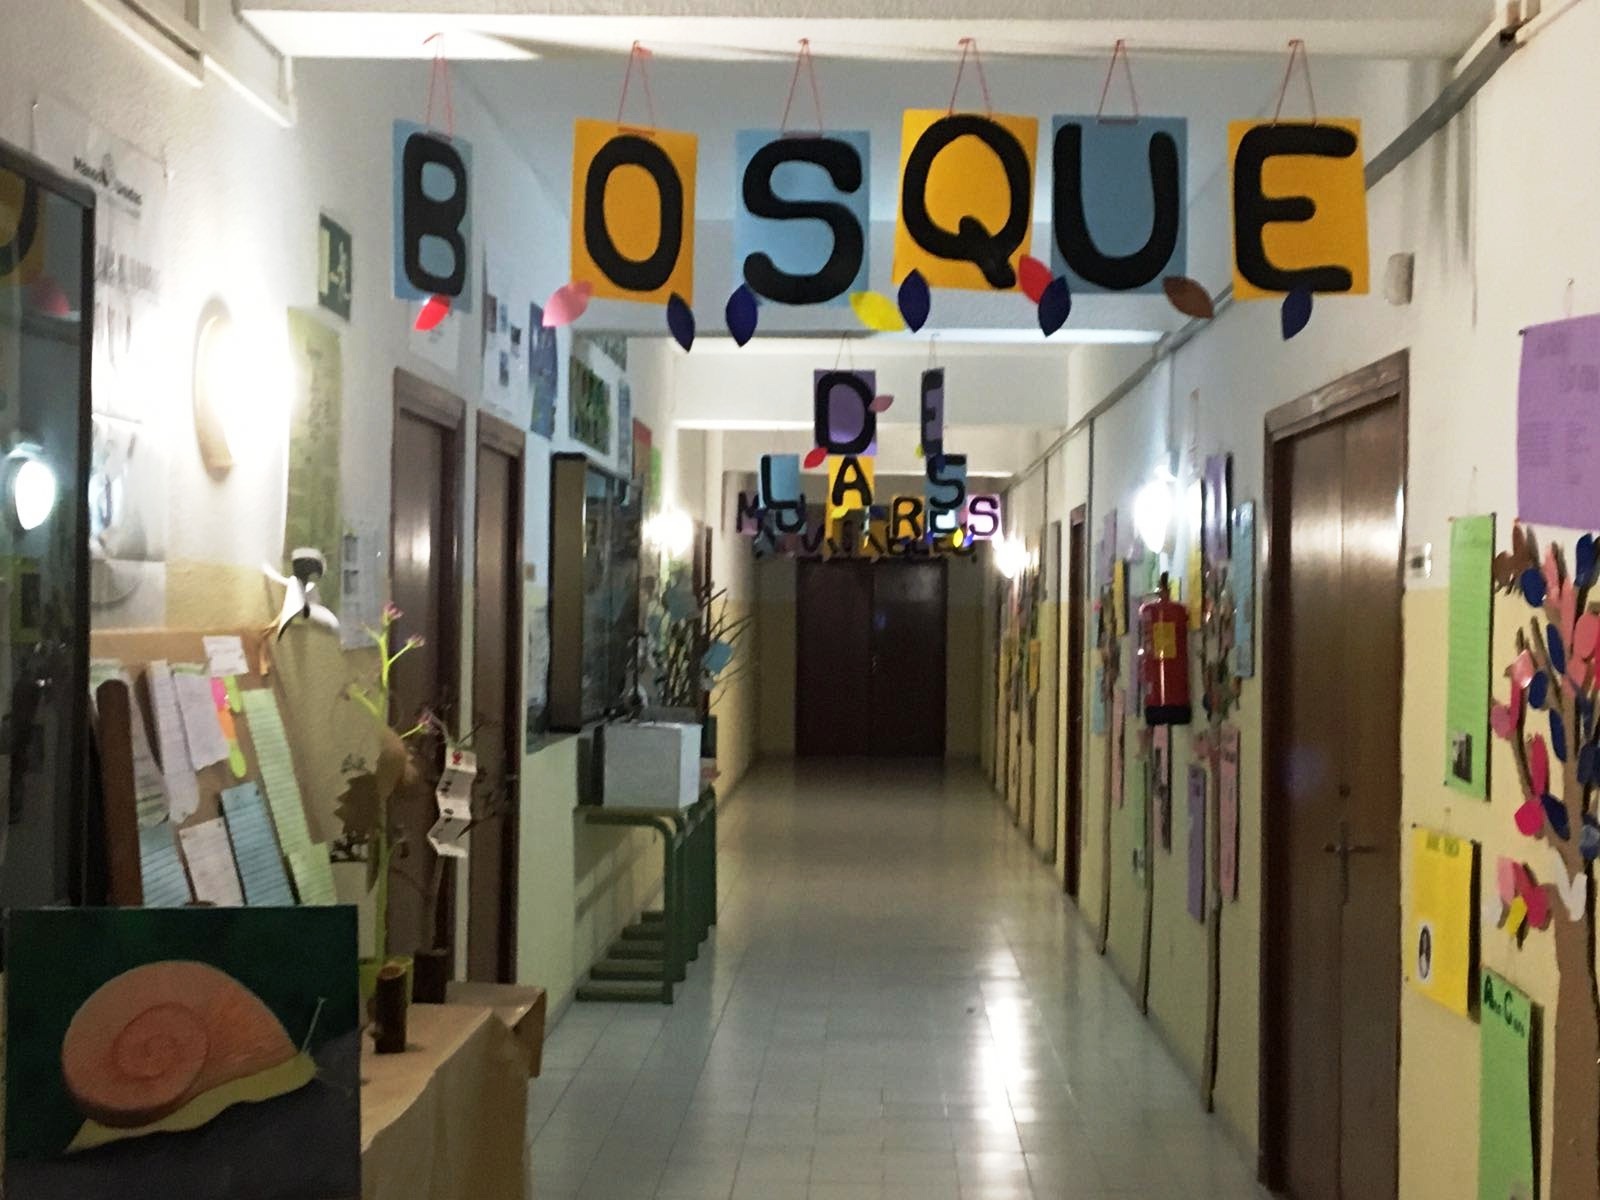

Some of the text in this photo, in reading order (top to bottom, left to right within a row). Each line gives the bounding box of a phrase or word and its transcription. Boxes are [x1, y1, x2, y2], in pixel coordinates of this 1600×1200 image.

[403, 115, 1358, 304] BOSQUE
[815, 371, 944, 456] DE
[736, 491, 999, 537] MURES
[761, 454, 966, 509] LAS
